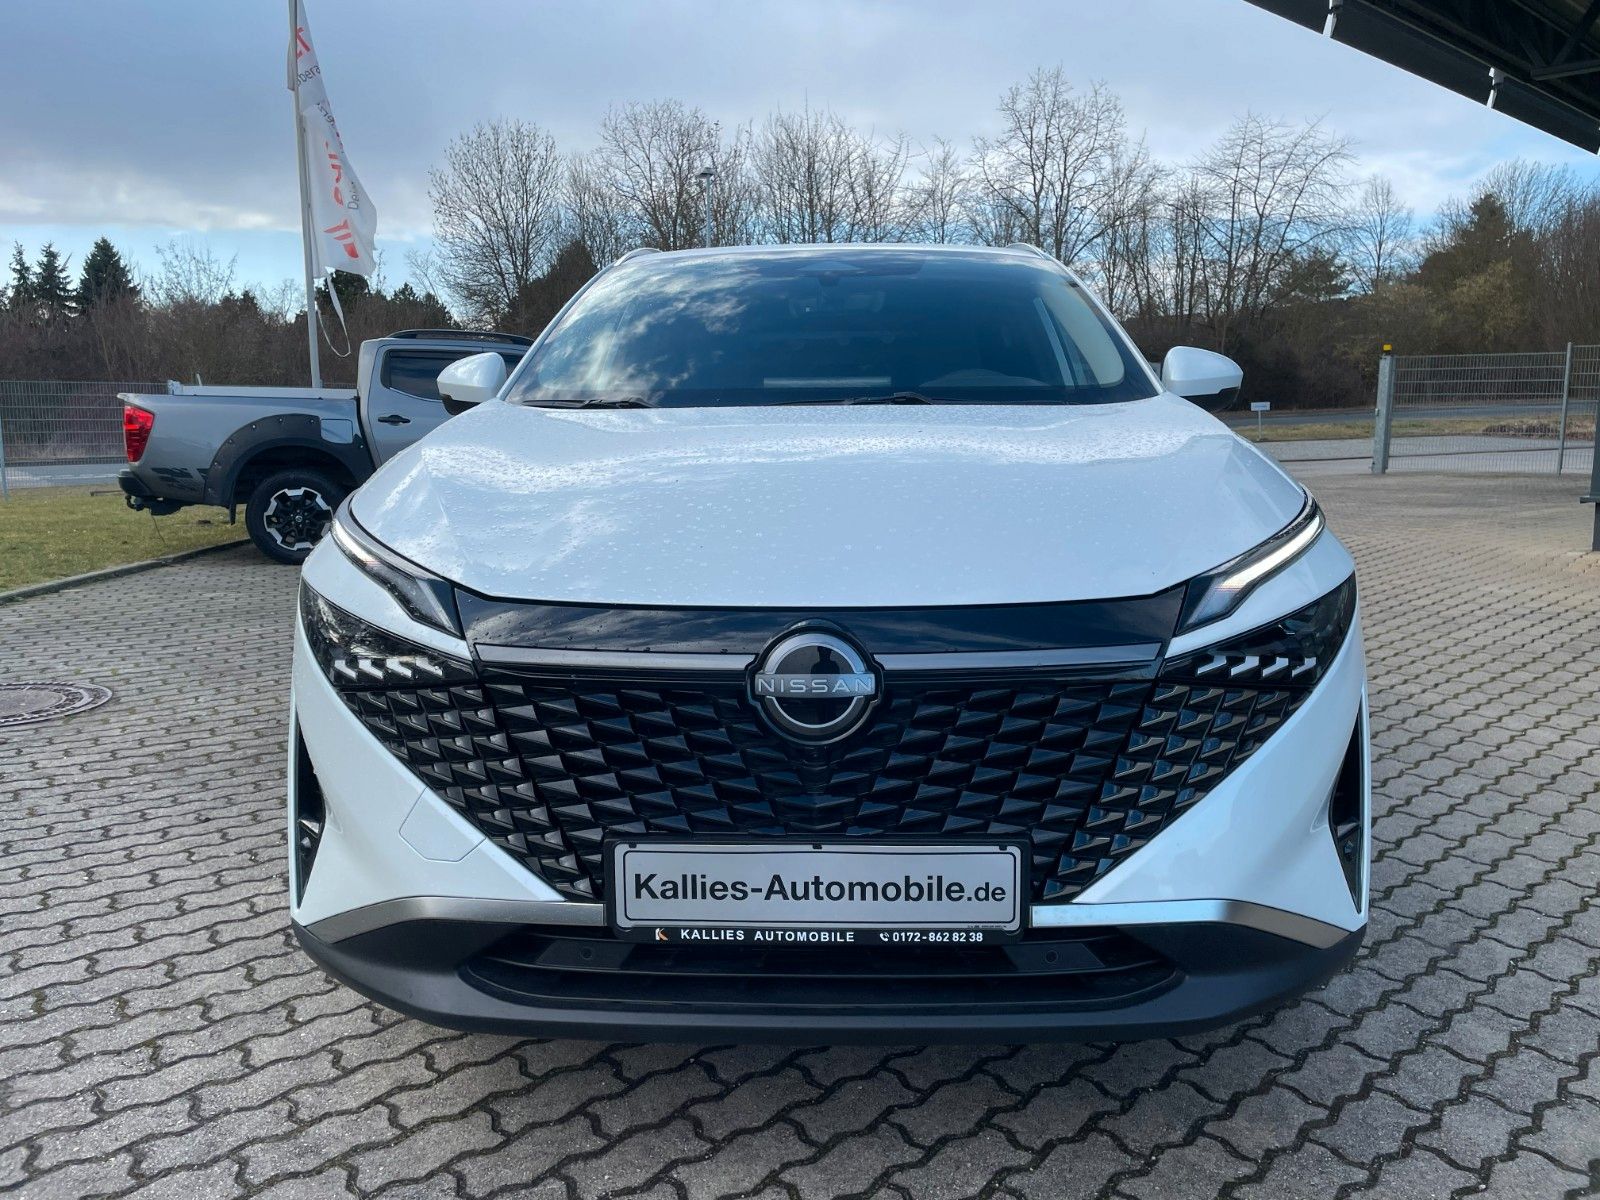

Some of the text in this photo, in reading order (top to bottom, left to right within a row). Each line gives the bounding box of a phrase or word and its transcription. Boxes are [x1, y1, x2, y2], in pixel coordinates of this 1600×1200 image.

[758, 678, 872, 693] NISSAN
[634, 873, 1006, 902] Kallies-Automobile.de
[681, 929, 745, 941] KALLIES
[754, 931, 855, 942] AUTOMOBILE
[892, 932, 983, 942] 0172-862 82 38
